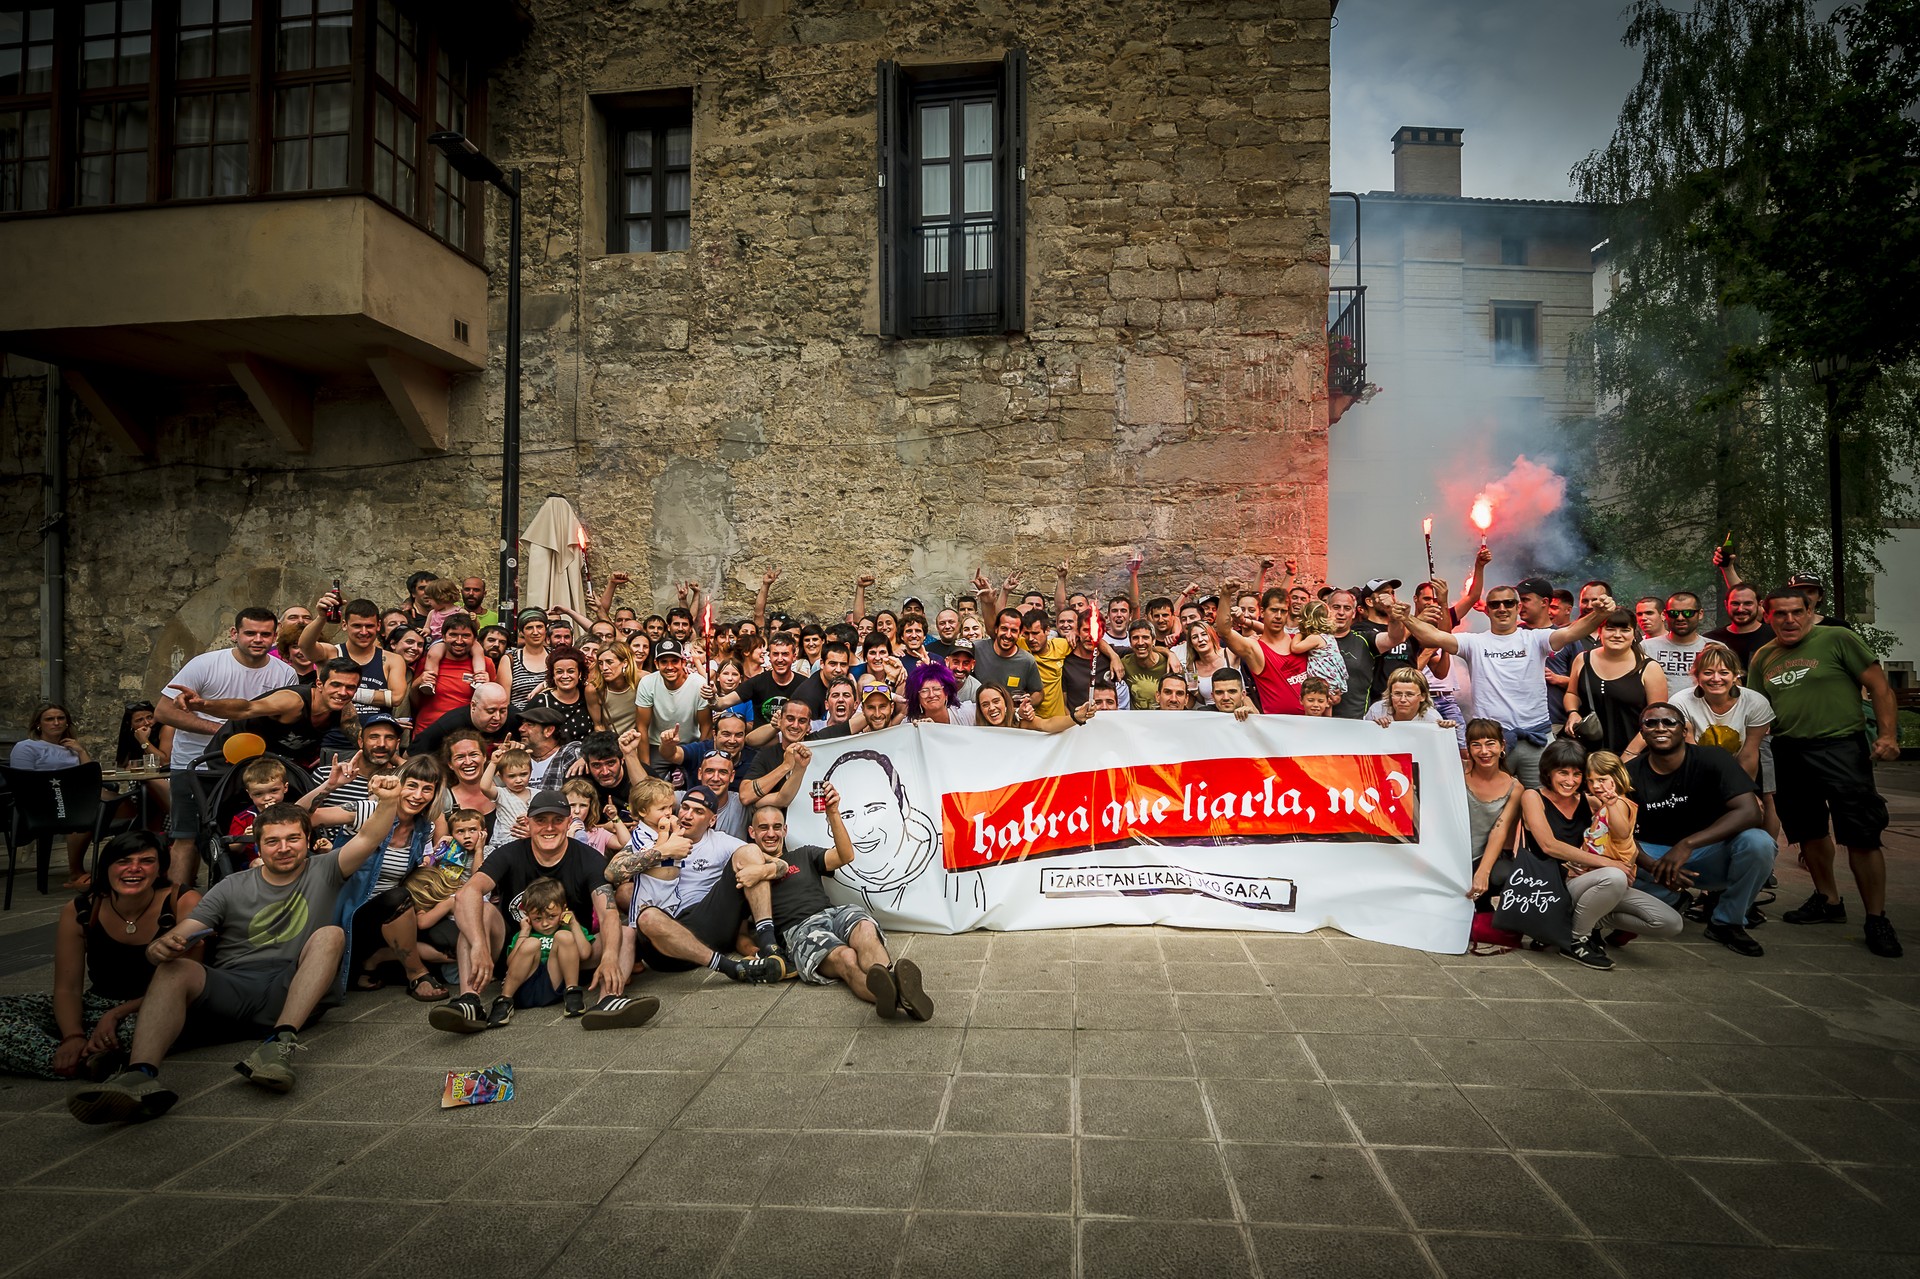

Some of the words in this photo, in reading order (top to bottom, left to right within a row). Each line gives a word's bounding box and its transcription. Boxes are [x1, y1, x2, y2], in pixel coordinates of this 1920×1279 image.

[1657, 650, 1700, 662] FRE
[52, 787, 66, 818] Heineken
[1102, 796, 1171, 834] que
[1182, 775, 1316, 823] liarla,
[1327, 770, 1410, 814] no?
[1509, 867, 1549, 888] Gora
[1224, 882, 1271, 900] GARA
[1501, 888, 1561, 913] Bizitza
